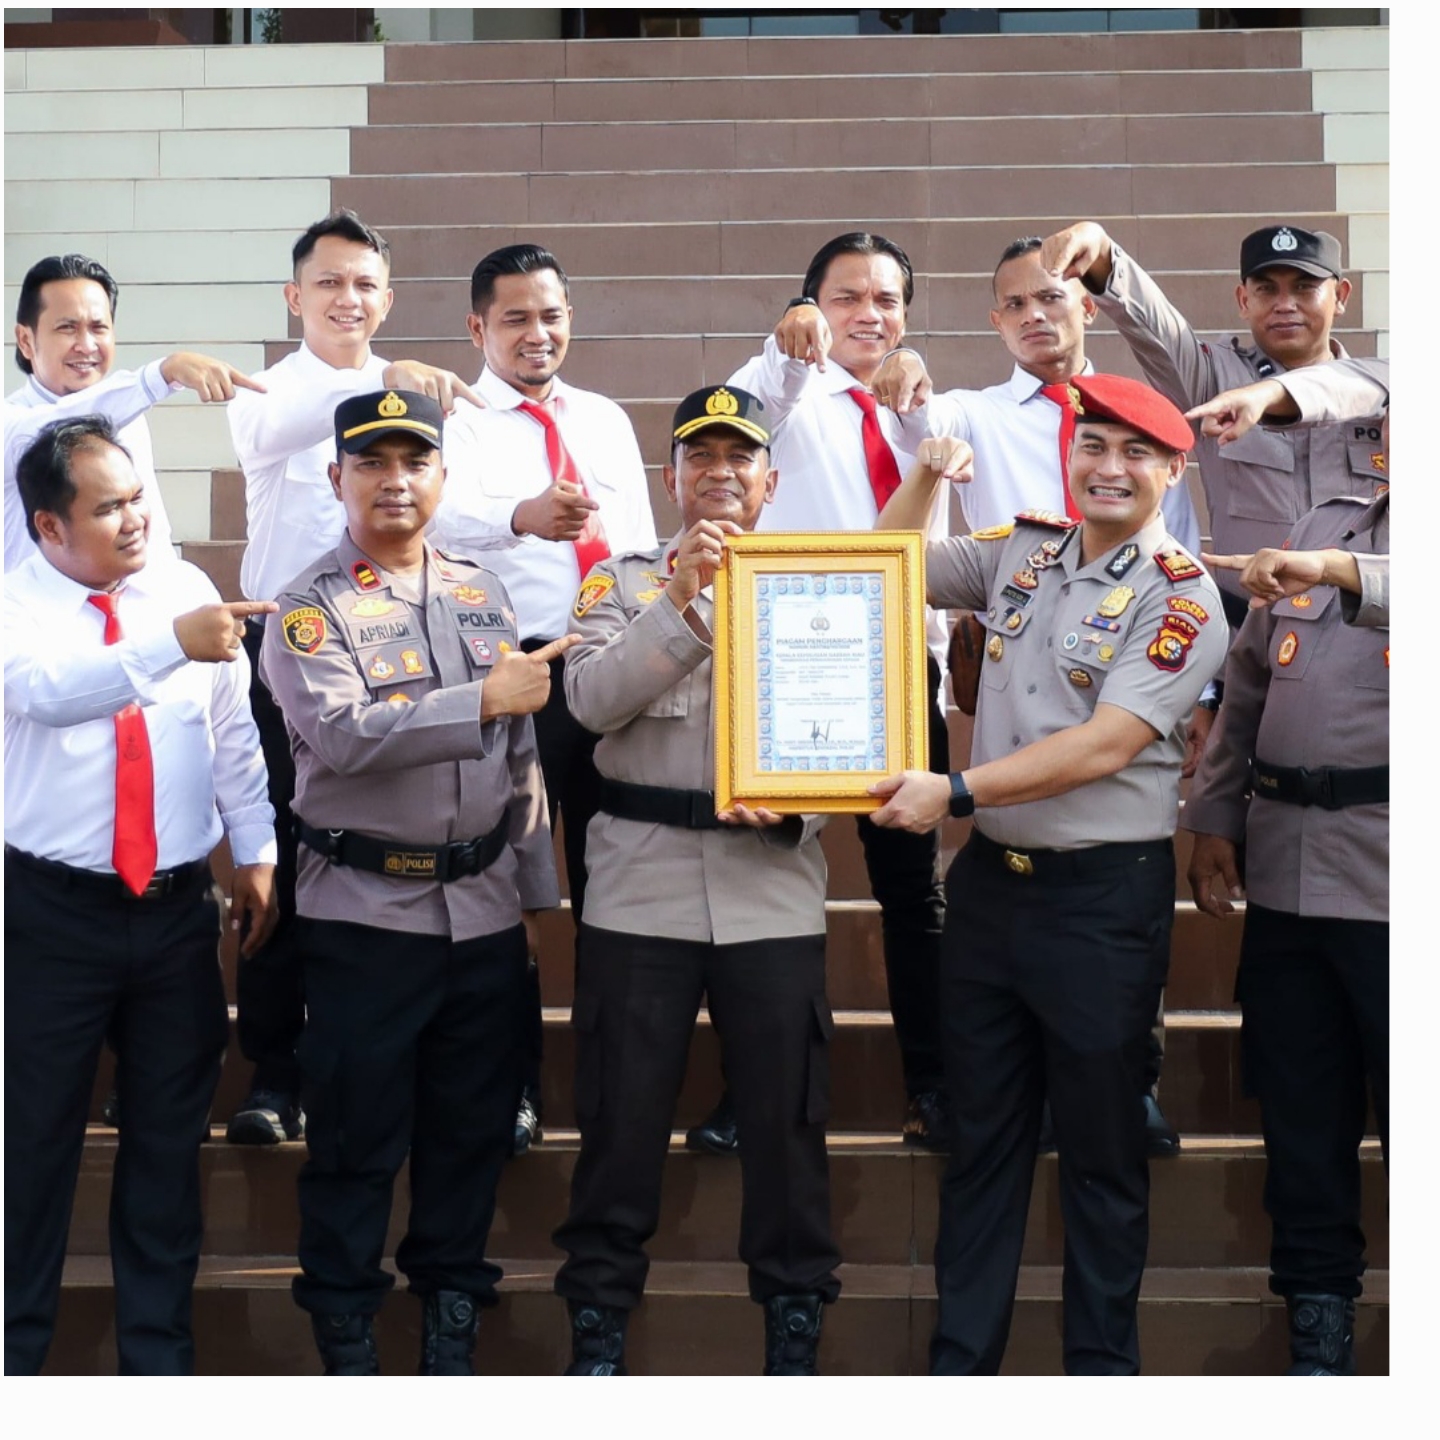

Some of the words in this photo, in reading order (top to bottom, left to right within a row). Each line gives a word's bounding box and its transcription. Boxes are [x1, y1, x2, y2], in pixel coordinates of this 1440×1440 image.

[1354, 427, 1381, 441] PO
[457, 612, 505, 627] POLRI
[360, 621, 410, 644] APRIADI
[406, 858, 434, 869] POLISI
